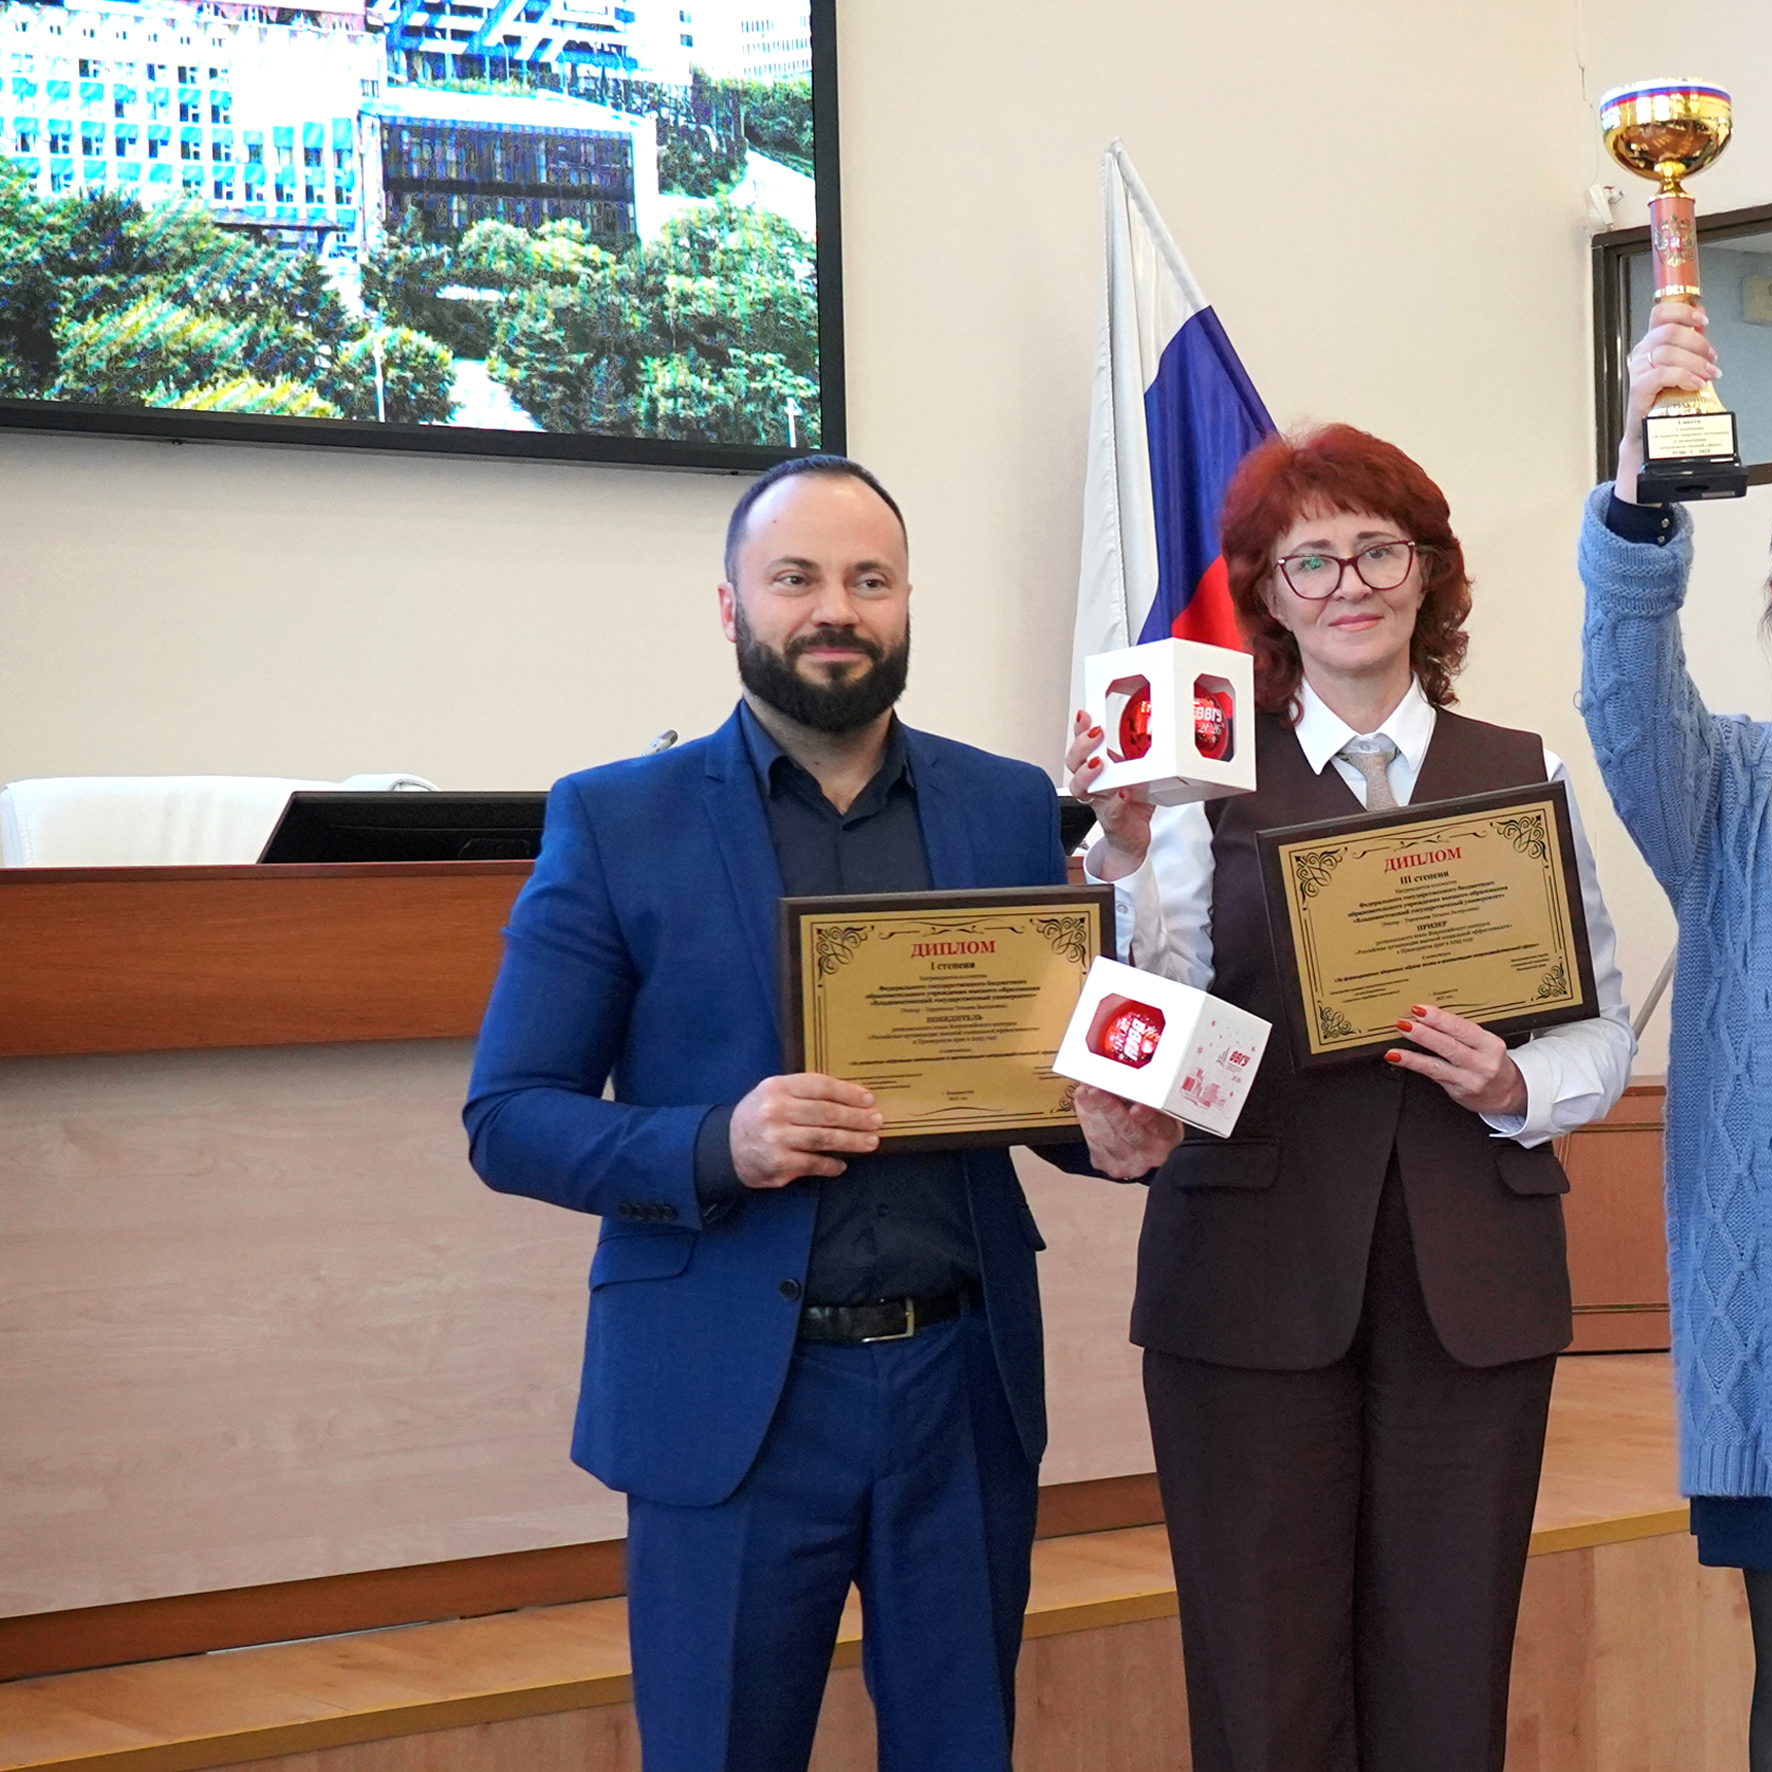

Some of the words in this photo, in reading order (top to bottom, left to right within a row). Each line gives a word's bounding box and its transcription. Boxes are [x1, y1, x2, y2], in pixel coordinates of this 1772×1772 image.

[1384, 847, 1462, 873] ДИПЛОМ
[1400, 875, 1411, 884] III
[1413, 869, 1449, 882] степени
[911, 940, 996, 958] ДИПЛОМ
